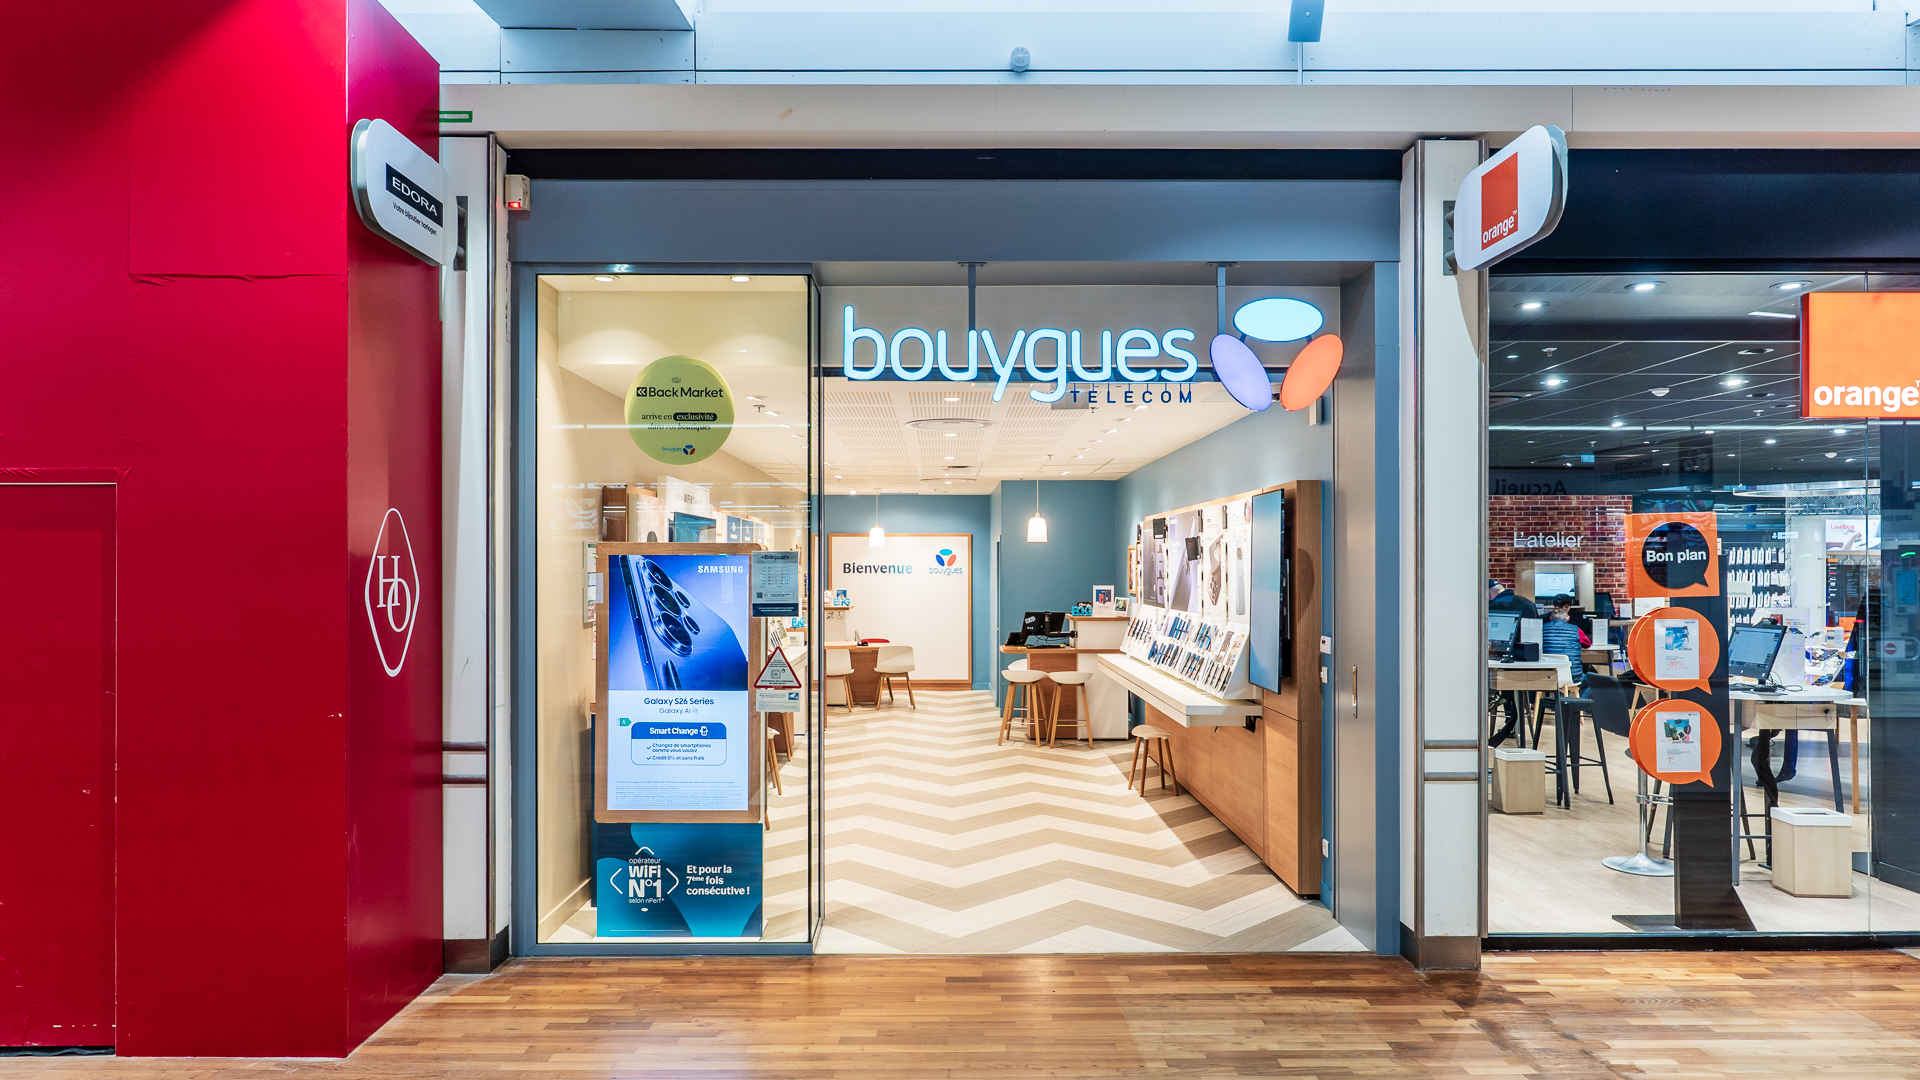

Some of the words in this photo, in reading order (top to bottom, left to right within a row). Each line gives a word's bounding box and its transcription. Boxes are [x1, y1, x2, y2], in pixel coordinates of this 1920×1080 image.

[392, 176, 438, 217] EDORA
[392, 202, 405, 216] Votre
[404, 209, 422, 226] bijoutier
[842, 304, 1198, 402] bouygues
[648, 386, 679, 398] Back
[680, 386, 724, 398] Market
[1070, 390, 1193, 404] TELECOM
[1646, 550, 1674, 562] Bon
[1677, 549, 1706, 563] plan
[698, 565, 744, 574] SAMSUNG
[843, 562, 912, 574] Bienvenue
[929, 566, 963, 575] bouygues
[644, 697, 673, 706] Galaxy
[672, 727, 698, 736] Change
[629, 865, 661, 878] WiFi
[686, 865, 697, 873] Et
[699, 867, 722, 876] pour
[723, 865, 732, 873] la
[706, 876, 723, 885] fois
[629, 879, 662, 898] N°1
[686, 886, 745, 895] consécutive
[747, 887, 750, 895] !
